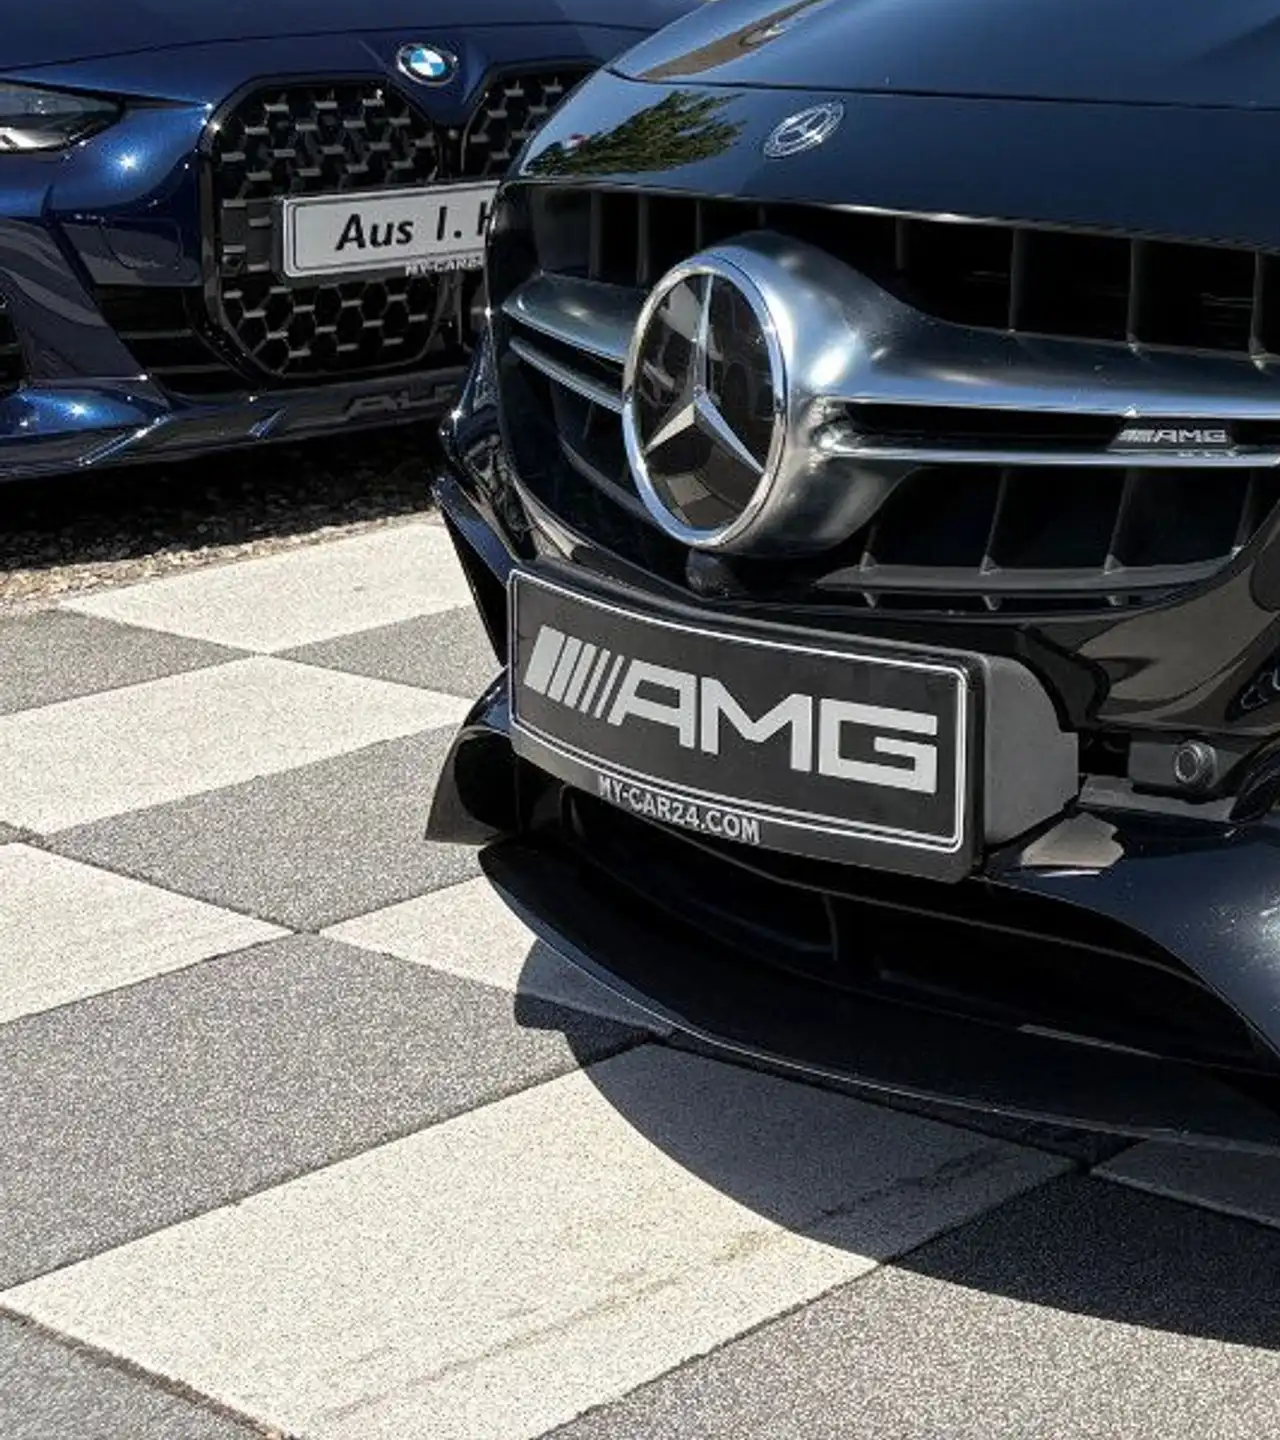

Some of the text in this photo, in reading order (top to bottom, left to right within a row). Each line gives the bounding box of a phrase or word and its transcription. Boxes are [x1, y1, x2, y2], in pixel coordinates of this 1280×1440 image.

[335, 213, 414, 251] Aus
[1154, 429, 1228, 443] AMG
[606, 658, 938, 794] AMG
[599, 773, 761, 846] MY-CAR24.COM
